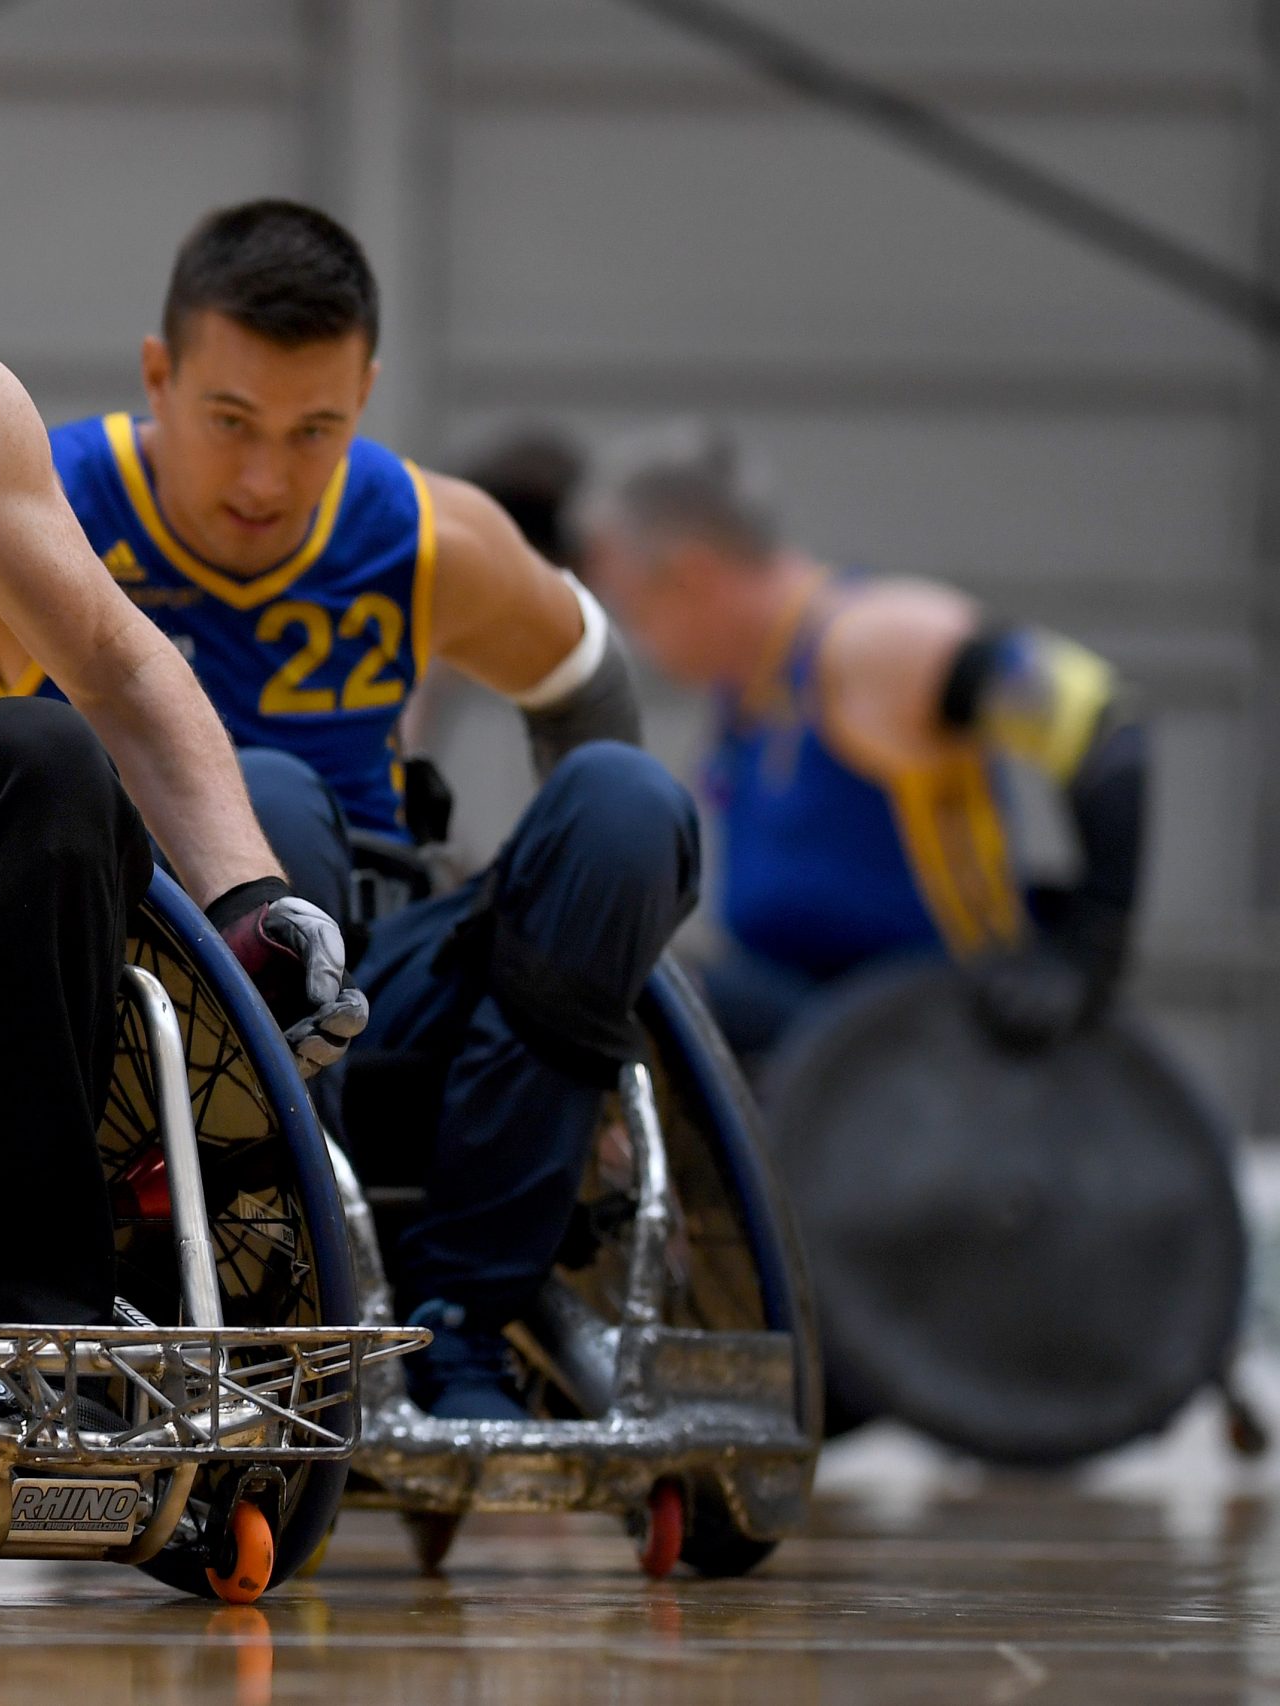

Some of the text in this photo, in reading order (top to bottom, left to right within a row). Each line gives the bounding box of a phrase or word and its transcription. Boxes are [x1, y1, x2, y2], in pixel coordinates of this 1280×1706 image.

[256, 592, 405, 717] 22
[12, 1487, 139, 1521] RHINO
[45, 1522, 73, 1531] RUGBY
